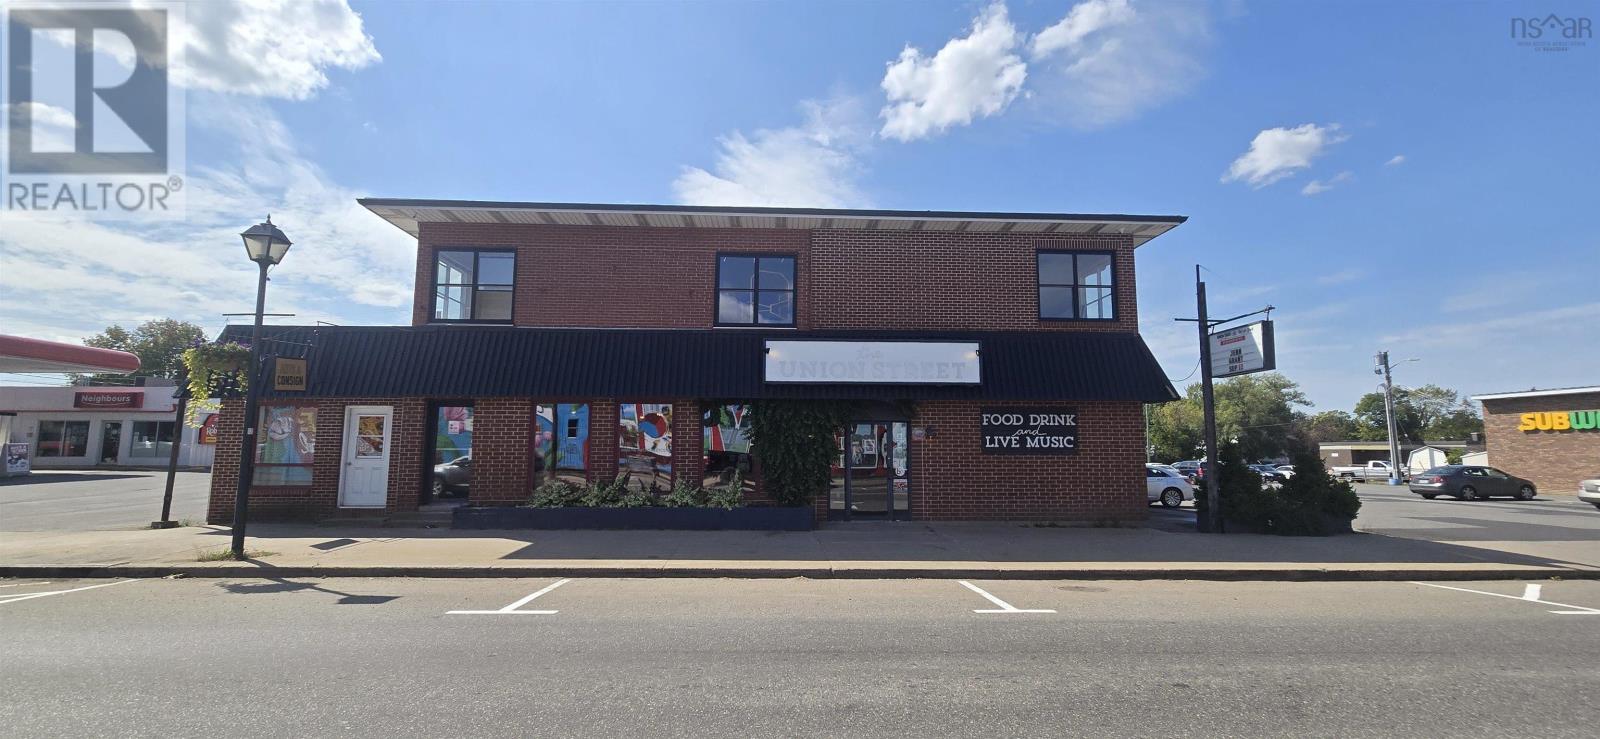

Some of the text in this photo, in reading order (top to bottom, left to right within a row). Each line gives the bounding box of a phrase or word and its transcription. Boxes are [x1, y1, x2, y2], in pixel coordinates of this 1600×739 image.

[779, 361, 966, 379] UNION STREET
[277, 376, 303, 385] CONSIGN
[81, 395, 131, 404] Neighbours
[982, 414, 1076, 426] FOOD DRINK
[1517, 409, 1600, 431] SUBW
[1011, 425, 1047, 437] and
[985, 436, 1075, 448] LIVE MUSIC
